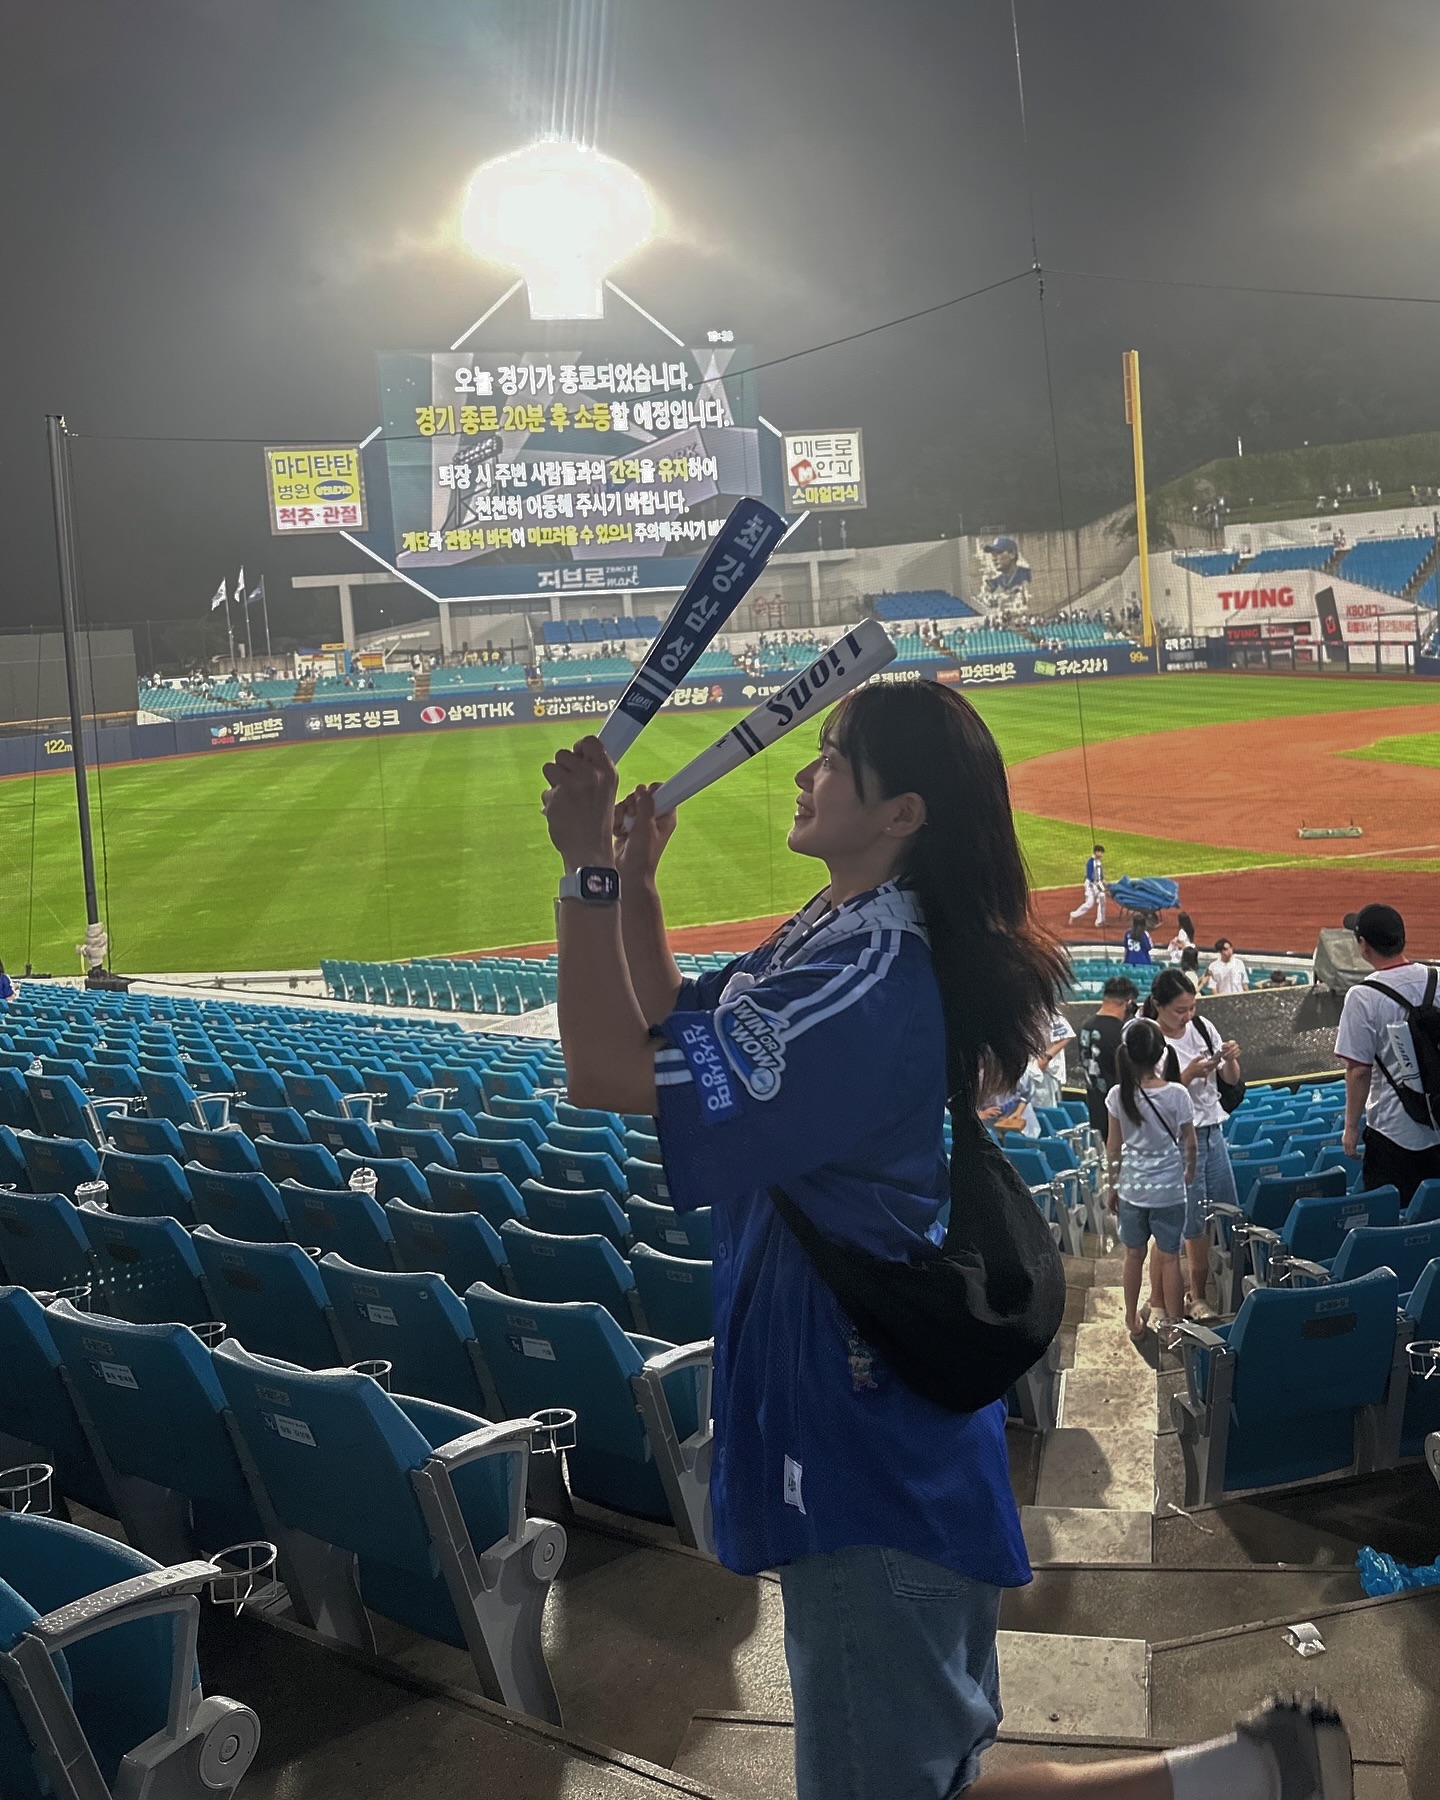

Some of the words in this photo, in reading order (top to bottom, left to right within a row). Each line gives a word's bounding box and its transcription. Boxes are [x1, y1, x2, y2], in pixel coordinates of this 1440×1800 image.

[454, 366, 494, 396] 오늘
[497, 364, 556, 395] 경기가
[559, 362, 694, 394] 종료되었습니다.
[415, 405, 456, 436] 경기
[460, 405, 500, 435] 종료
[503, 404, 546, 433] 20분
[550, 403, 570, 433] 후
[574, 401, 630, 432] 소등할
[633, 399, 730, 430] 예정입니다.
[275, 454, 353, 479] 마디탄탄
[438, 463, 472, 489] 퇴장
[475, 463, 492, 488] 시
[495, 461, 528, 487] 주변
[530, 460, 607, 487] 사람들과의
[610, 458, 656, 484] 간격을
[658, 456, 718, 482] 유지하여
[816, 459, 853, 478] 안과
[278, 484, 310, 500] 병원
[792, 484, 859, 505] 스마일라식
[476, 495, 523, 521] 천천히
[526, 493, 574, 519] 이동해
[576, 491, 622, 517] 주시기
[624, 489, 690, 515] 바랍니다.
[402, 530, 443, 553] 계단과
[445, 528, 485, 550] 관람석
[486, 527, 526, 549] 바닥이
[580, 525, 595, 545] 수
[595, 523, 633, 545] 있으니
[538, 567, 606, 589] 지브로
[607, 572, 640, 587] mart
[1218, 587, 1294, 611] TVING
[324, 709, 400, 730] 백조씽크
[448, 702, 515, 721] 삼익THK
[44, 739, 73, 754] 122m
[732, 1002, 774, 1037] WIN
[760, 1035, 779, 1052] OR
[730, 1020, 778, 1069] WOW
[683, 1024, 733, 1111] 삼성생명
